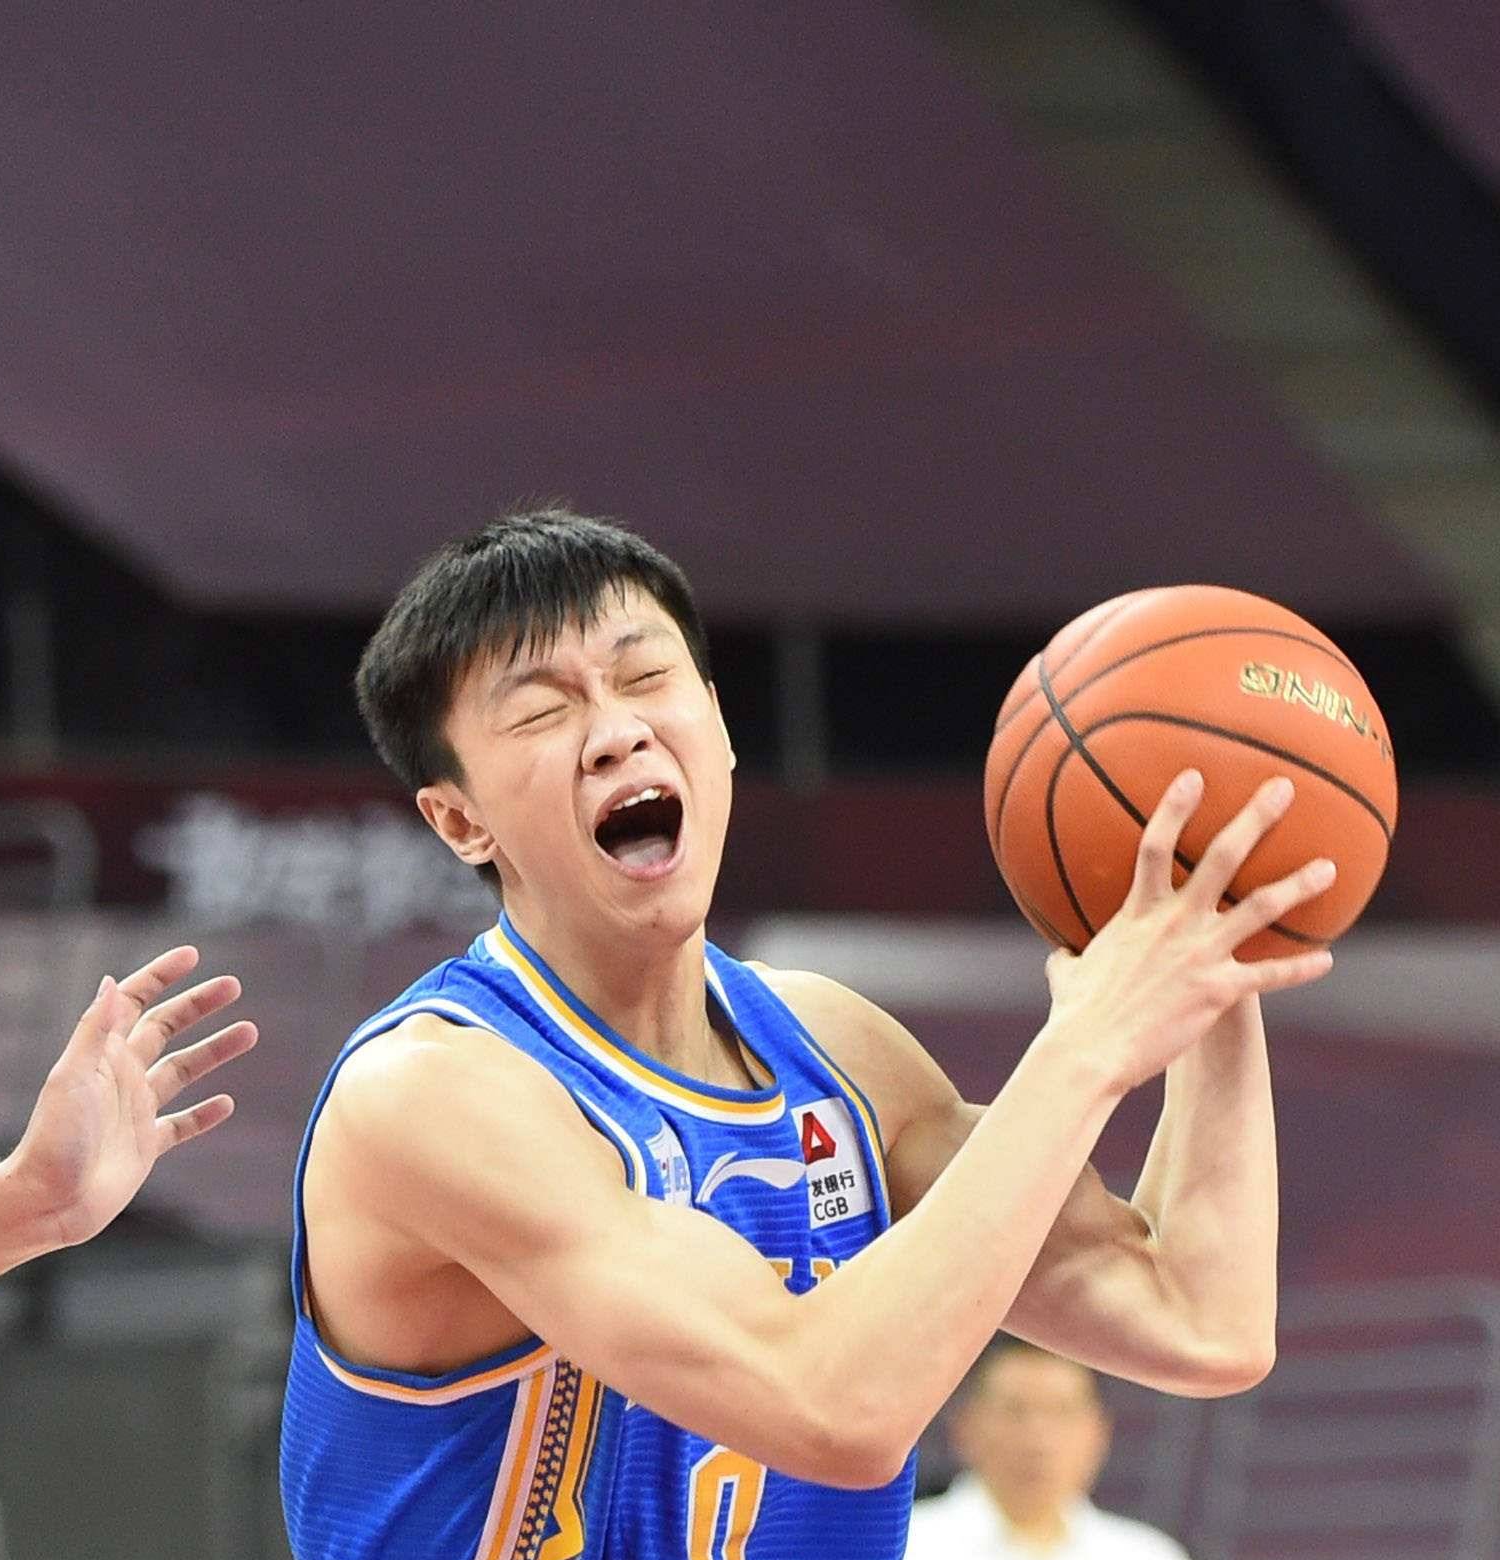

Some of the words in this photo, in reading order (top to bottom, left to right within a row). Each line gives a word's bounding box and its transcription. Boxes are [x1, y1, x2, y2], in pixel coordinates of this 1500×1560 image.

[1240, 660, 1393, 762] -NING
[806, 1169, 856, 1198] 发银行
[813, 1196, 849, 1221] CGB
